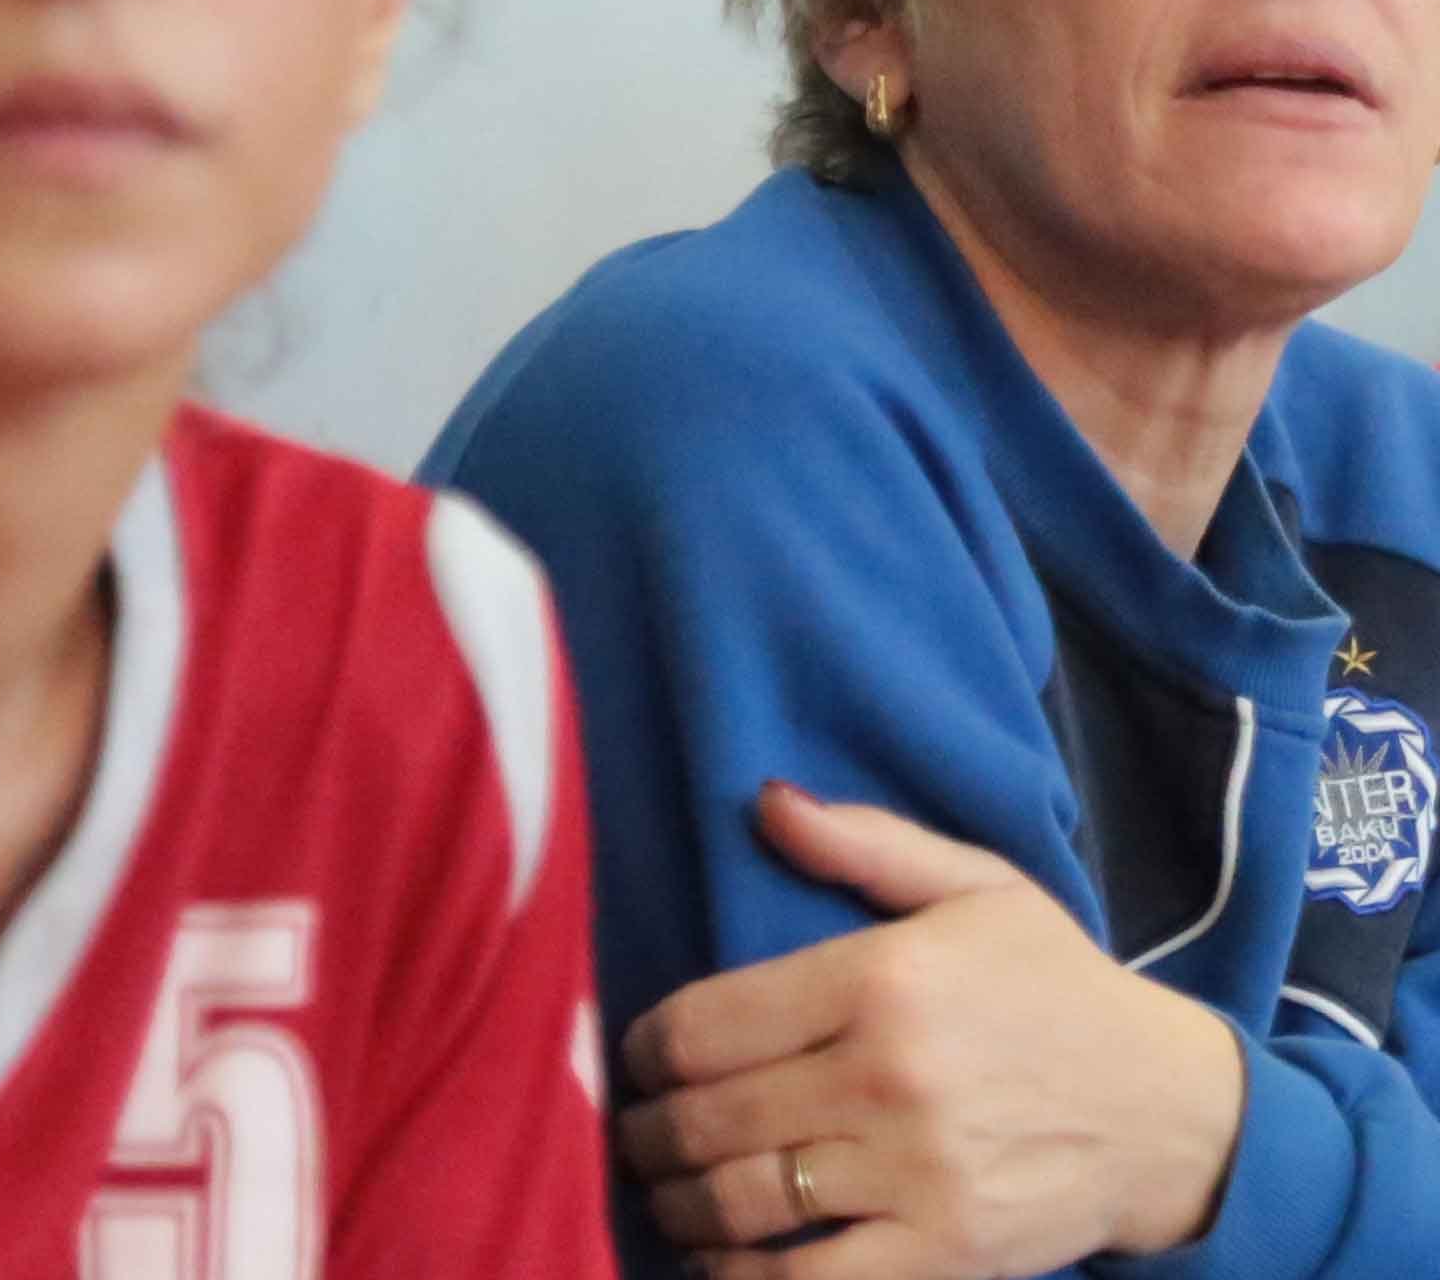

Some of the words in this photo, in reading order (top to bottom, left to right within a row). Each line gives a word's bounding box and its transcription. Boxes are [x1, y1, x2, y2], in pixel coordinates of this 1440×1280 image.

[1313, 769, 1417, 821] NTER
[1315, 818, 1400, 847] BAKU
[1336, 841, 1396, 865] 2004
